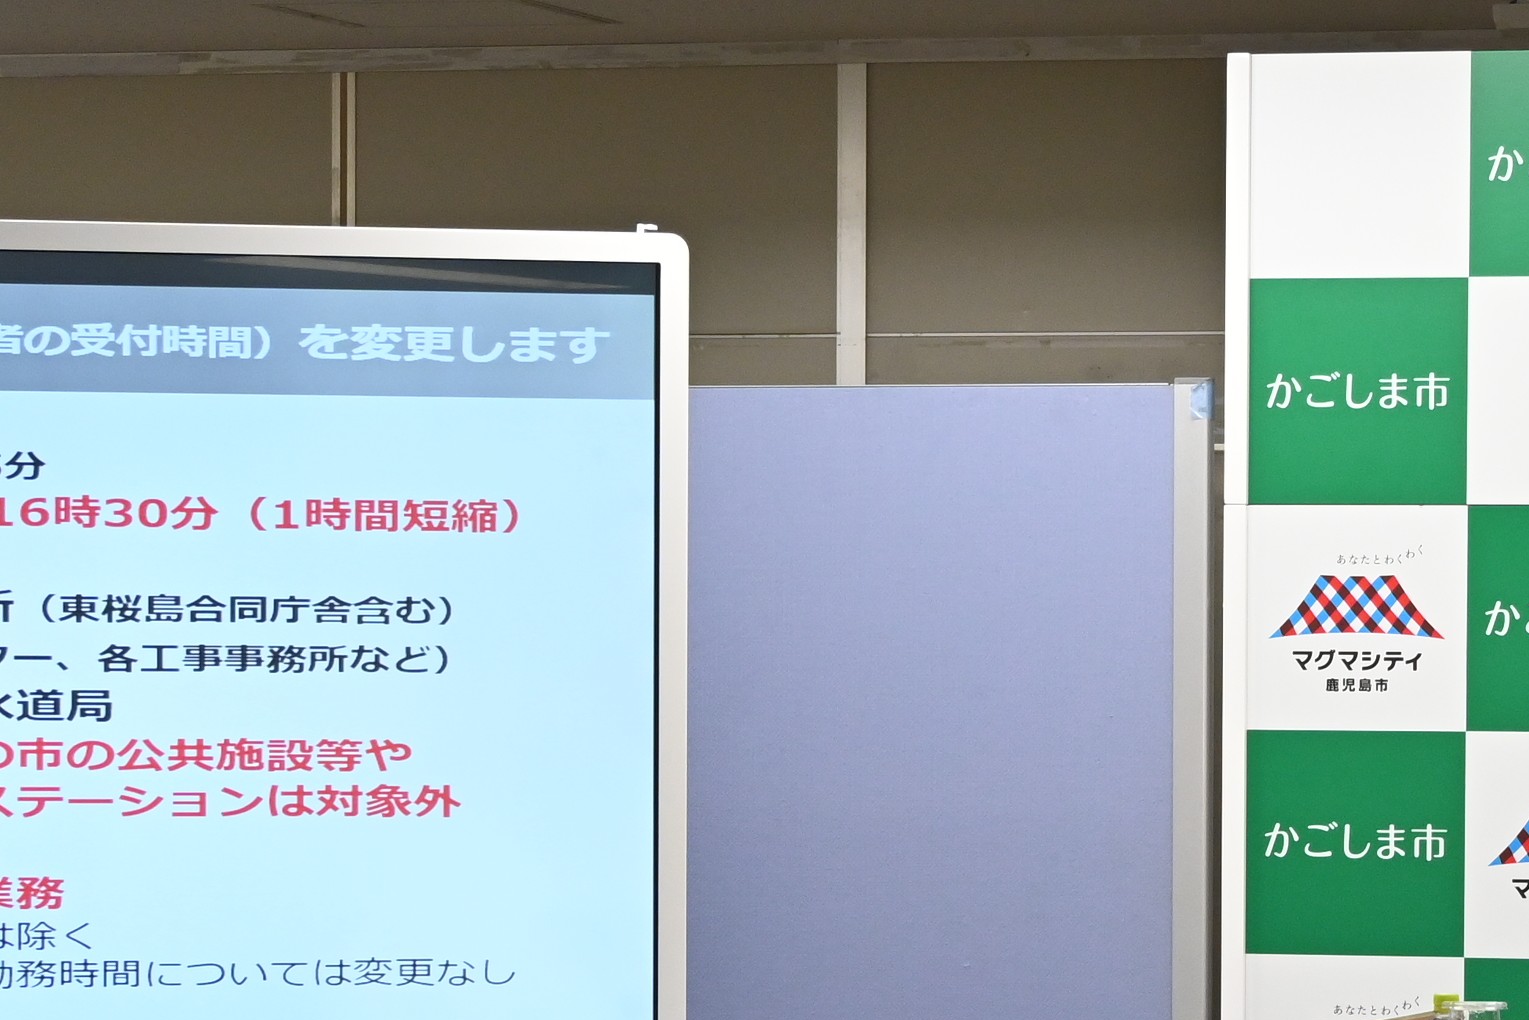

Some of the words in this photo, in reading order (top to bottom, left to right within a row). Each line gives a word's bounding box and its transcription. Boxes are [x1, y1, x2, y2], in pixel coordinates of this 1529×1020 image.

[1266, 370, 1451, 411] かごしま市
[0, 451, 46, 481] 分
[1336, 544, 1423, 565] あなたとわくわく
[1292, 649, 1422, 672] マグマシティ
[1325, 677, 1389, 693] 鹿児島市
[1264, 820, 1448, 862] かごしま市
[1333, 996, 1420, 1016] あなたとわくわく
